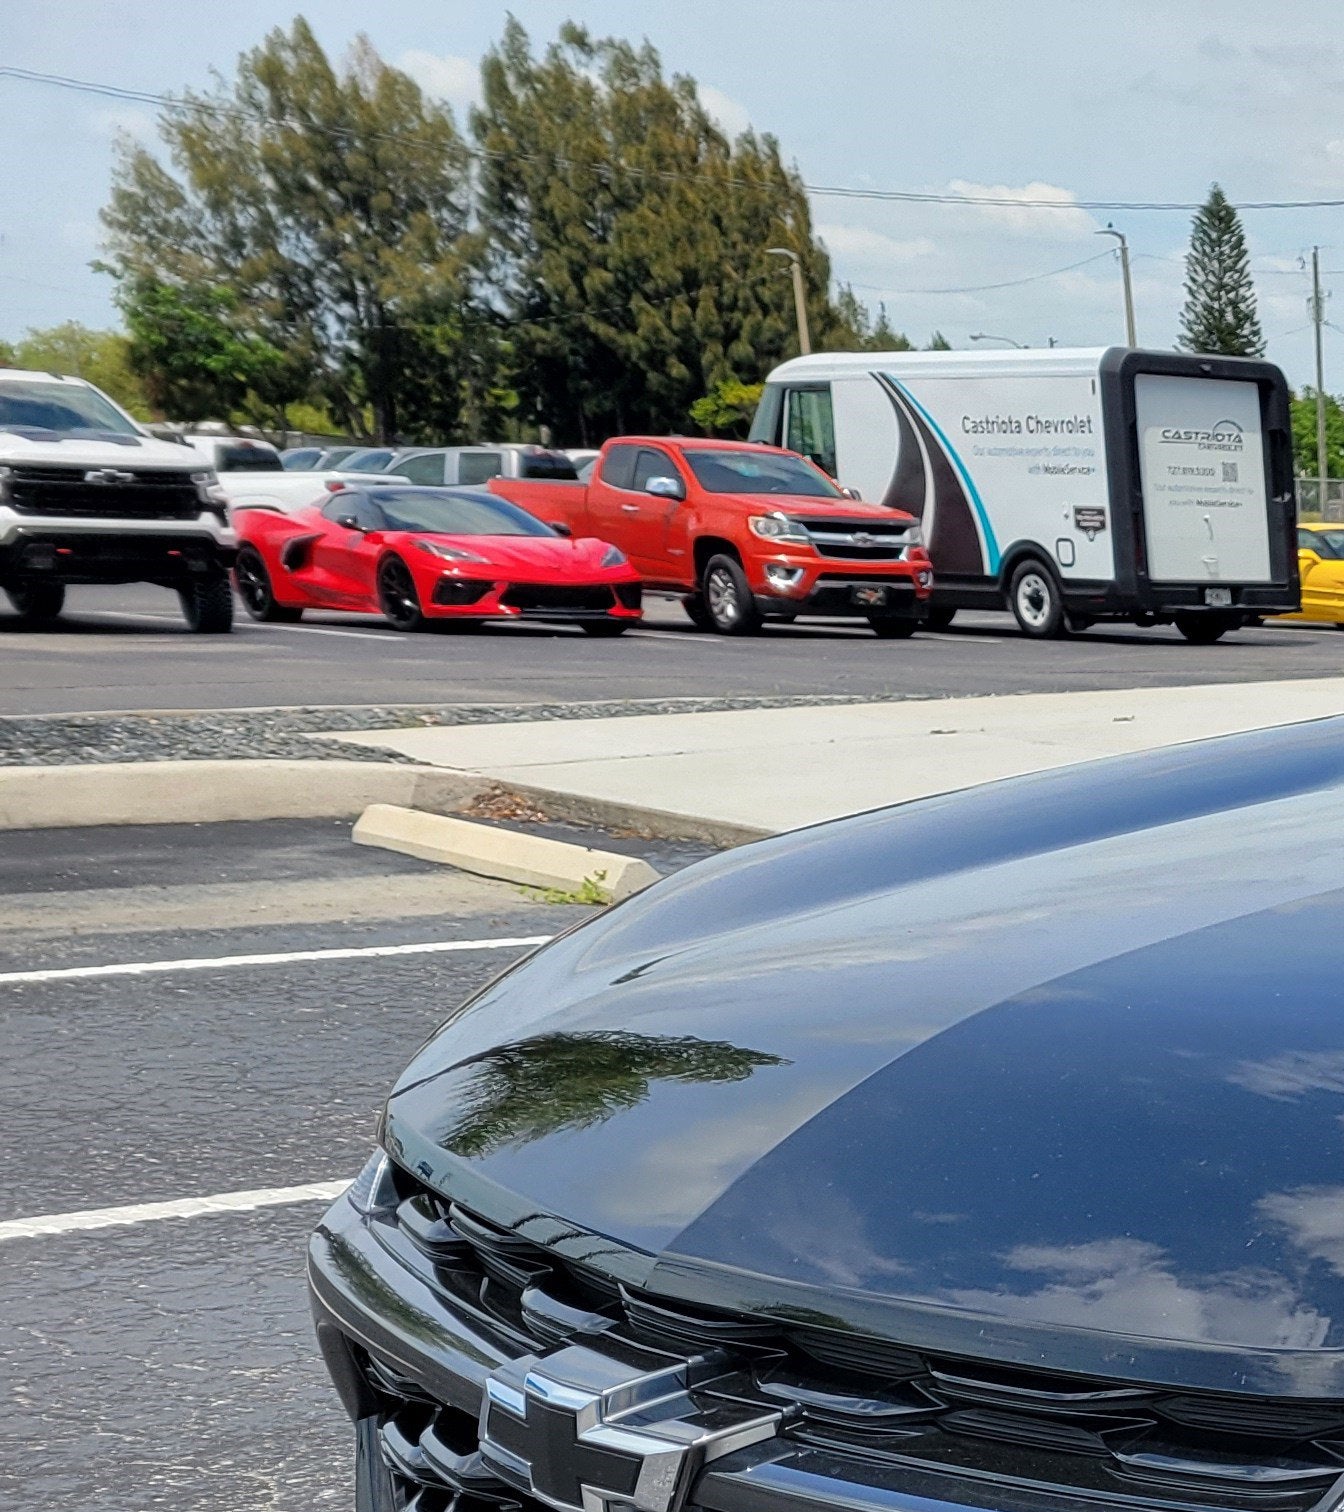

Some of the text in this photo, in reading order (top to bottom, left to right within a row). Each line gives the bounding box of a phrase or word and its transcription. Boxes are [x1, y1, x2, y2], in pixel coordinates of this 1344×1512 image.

[961, 415, 1093, 434] Castriota Chevrolet
[1161, 429, 1243, 443] CASTRIOTA
